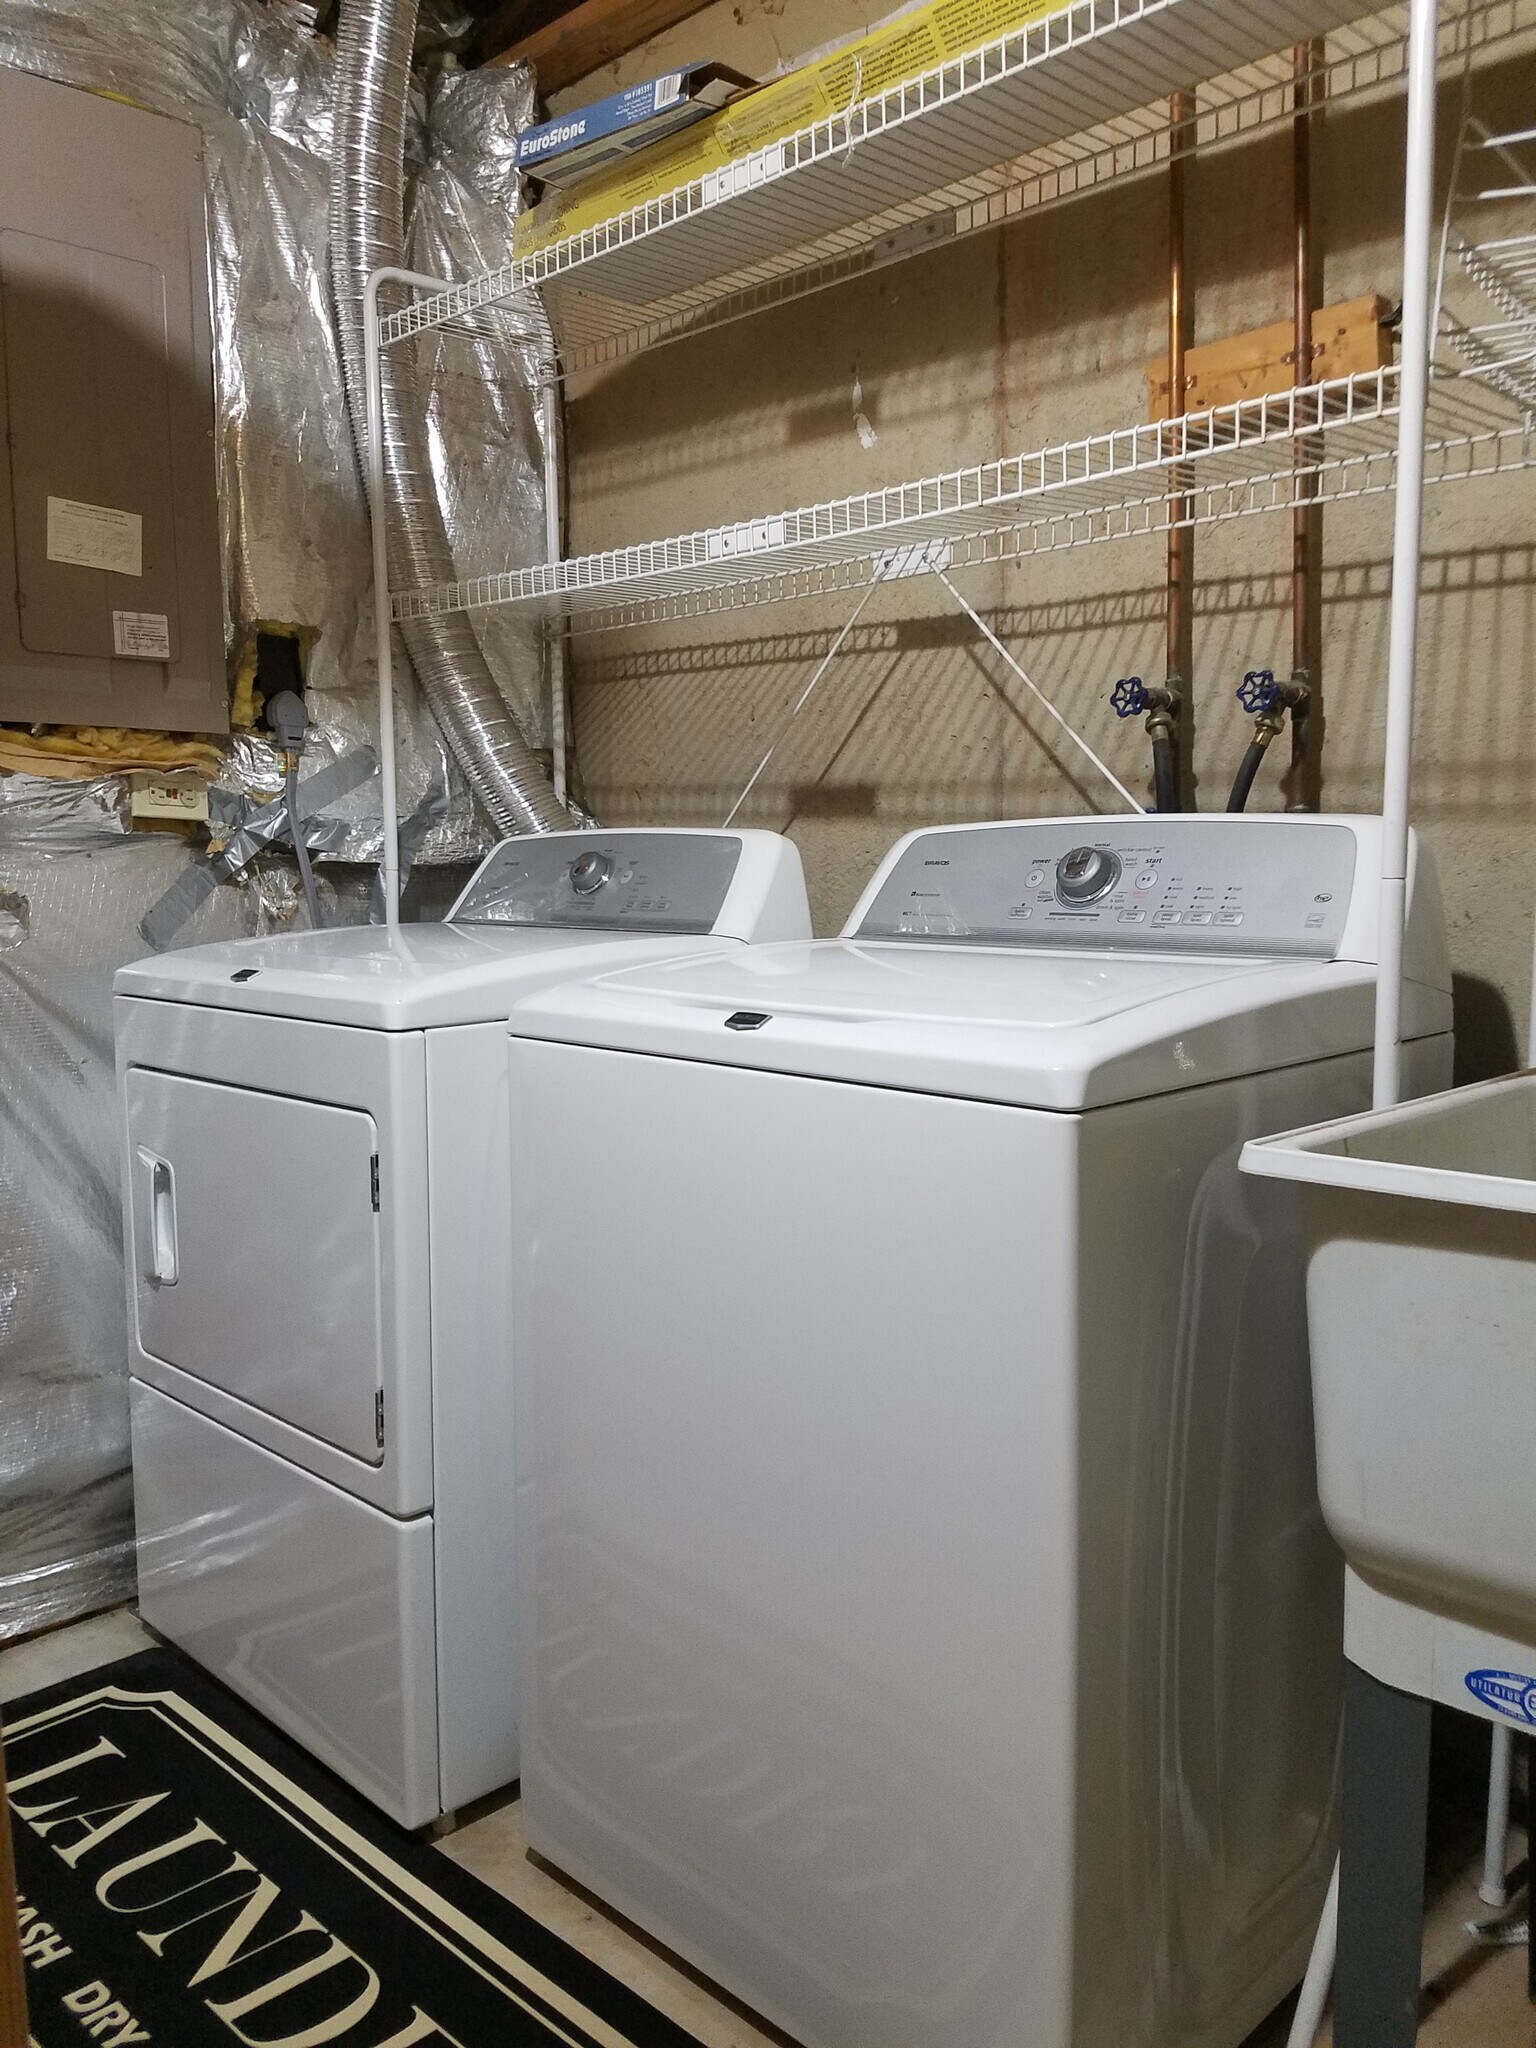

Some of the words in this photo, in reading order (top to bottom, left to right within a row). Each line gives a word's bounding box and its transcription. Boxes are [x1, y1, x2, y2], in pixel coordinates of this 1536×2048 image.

[520, 119, 586, 157] EuroStone
[1030, 858, 1052, 866] power
[1144, 857, 1163, 865] start
[1470, 1676, 1520, 1703] UTILATUB
[6, 1735, 465, 2048] LAUND
[15, 1893, 74, 1970] ASH
[61, 1979, 152, 2048] DRY
